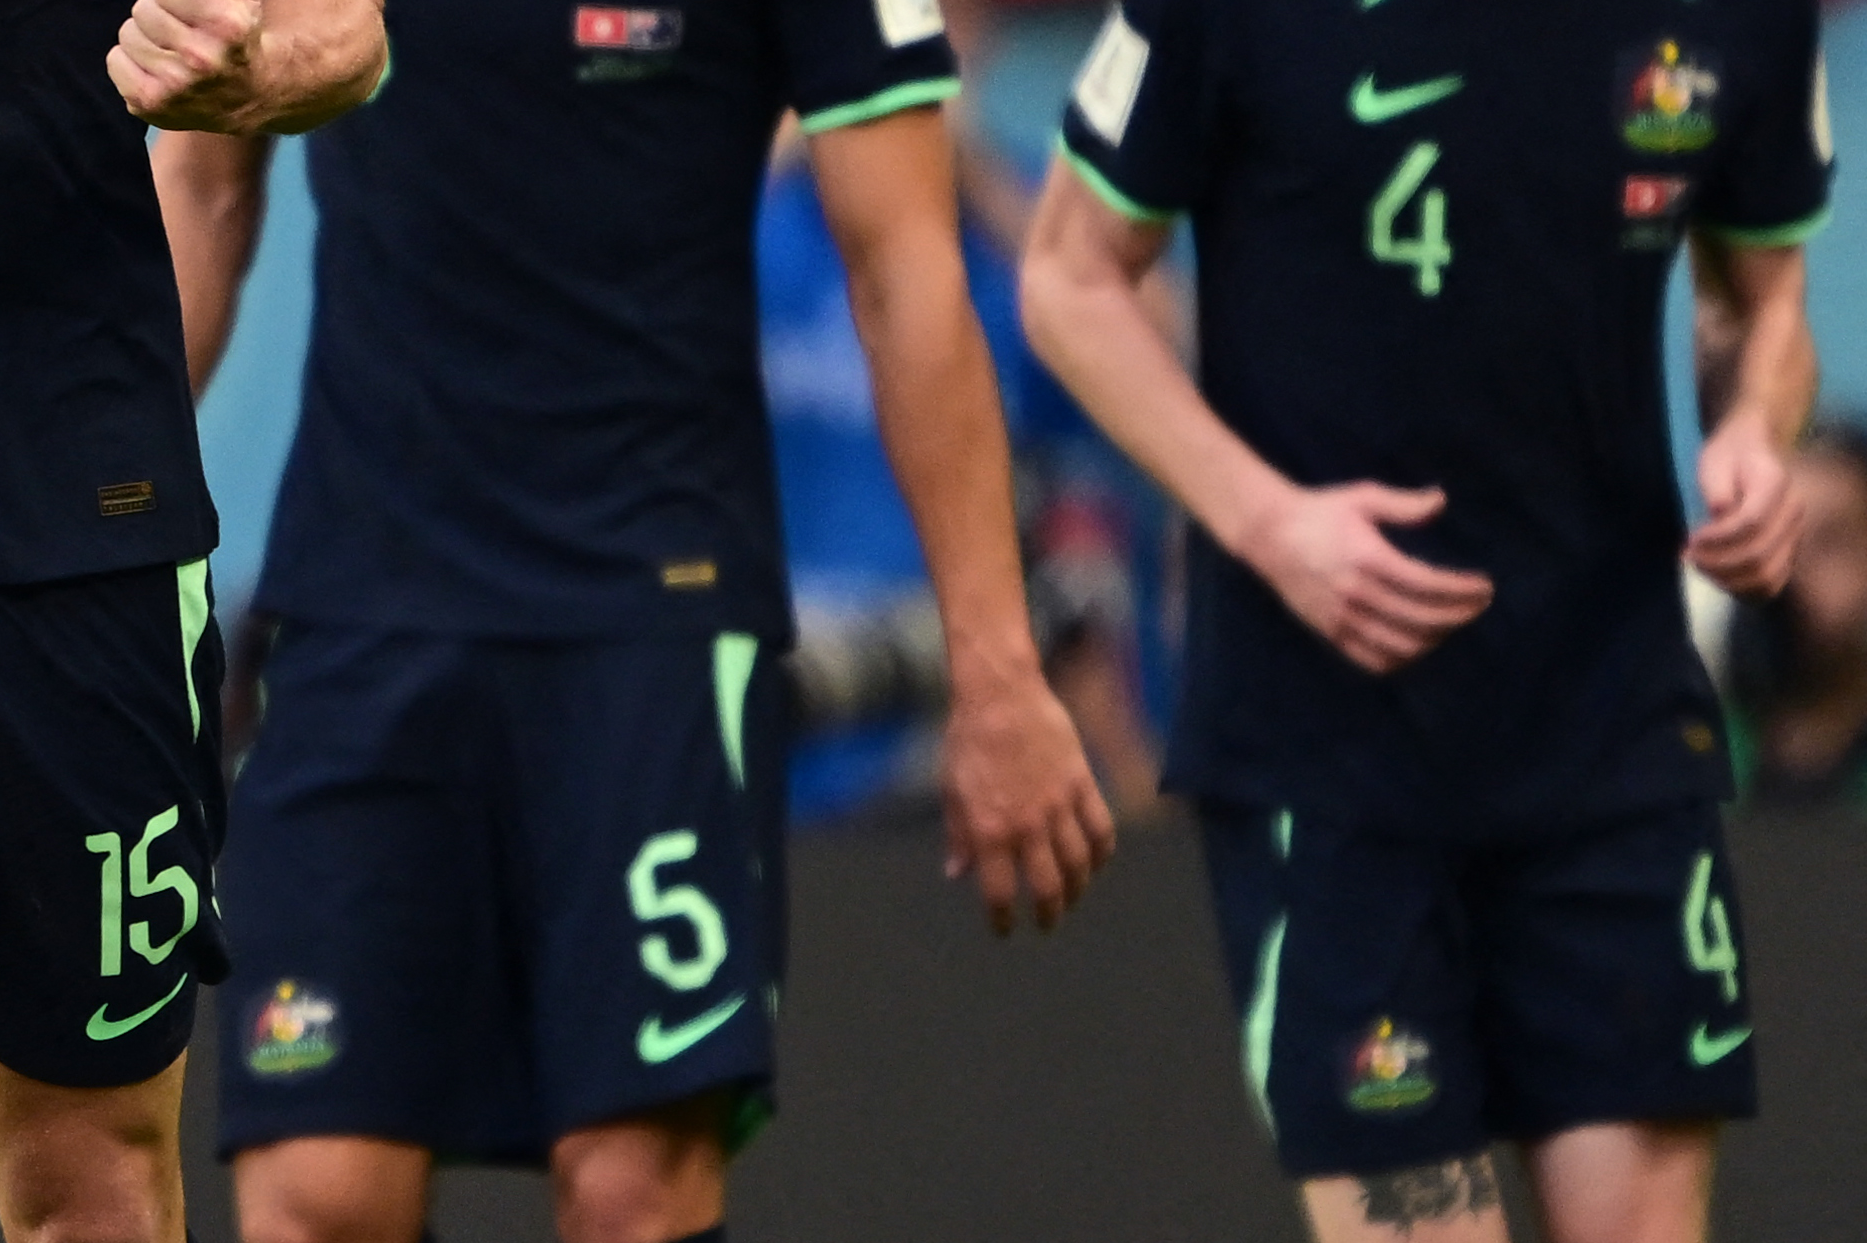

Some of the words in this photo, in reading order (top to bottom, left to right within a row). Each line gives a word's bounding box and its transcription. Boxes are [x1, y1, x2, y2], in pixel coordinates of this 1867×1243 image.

[1371, 142, 1452, 297] 4
[85, 804, 200, 977] 15
[626, 828, 729, 992] 5
[1683, 854, 1739, 999] 4
